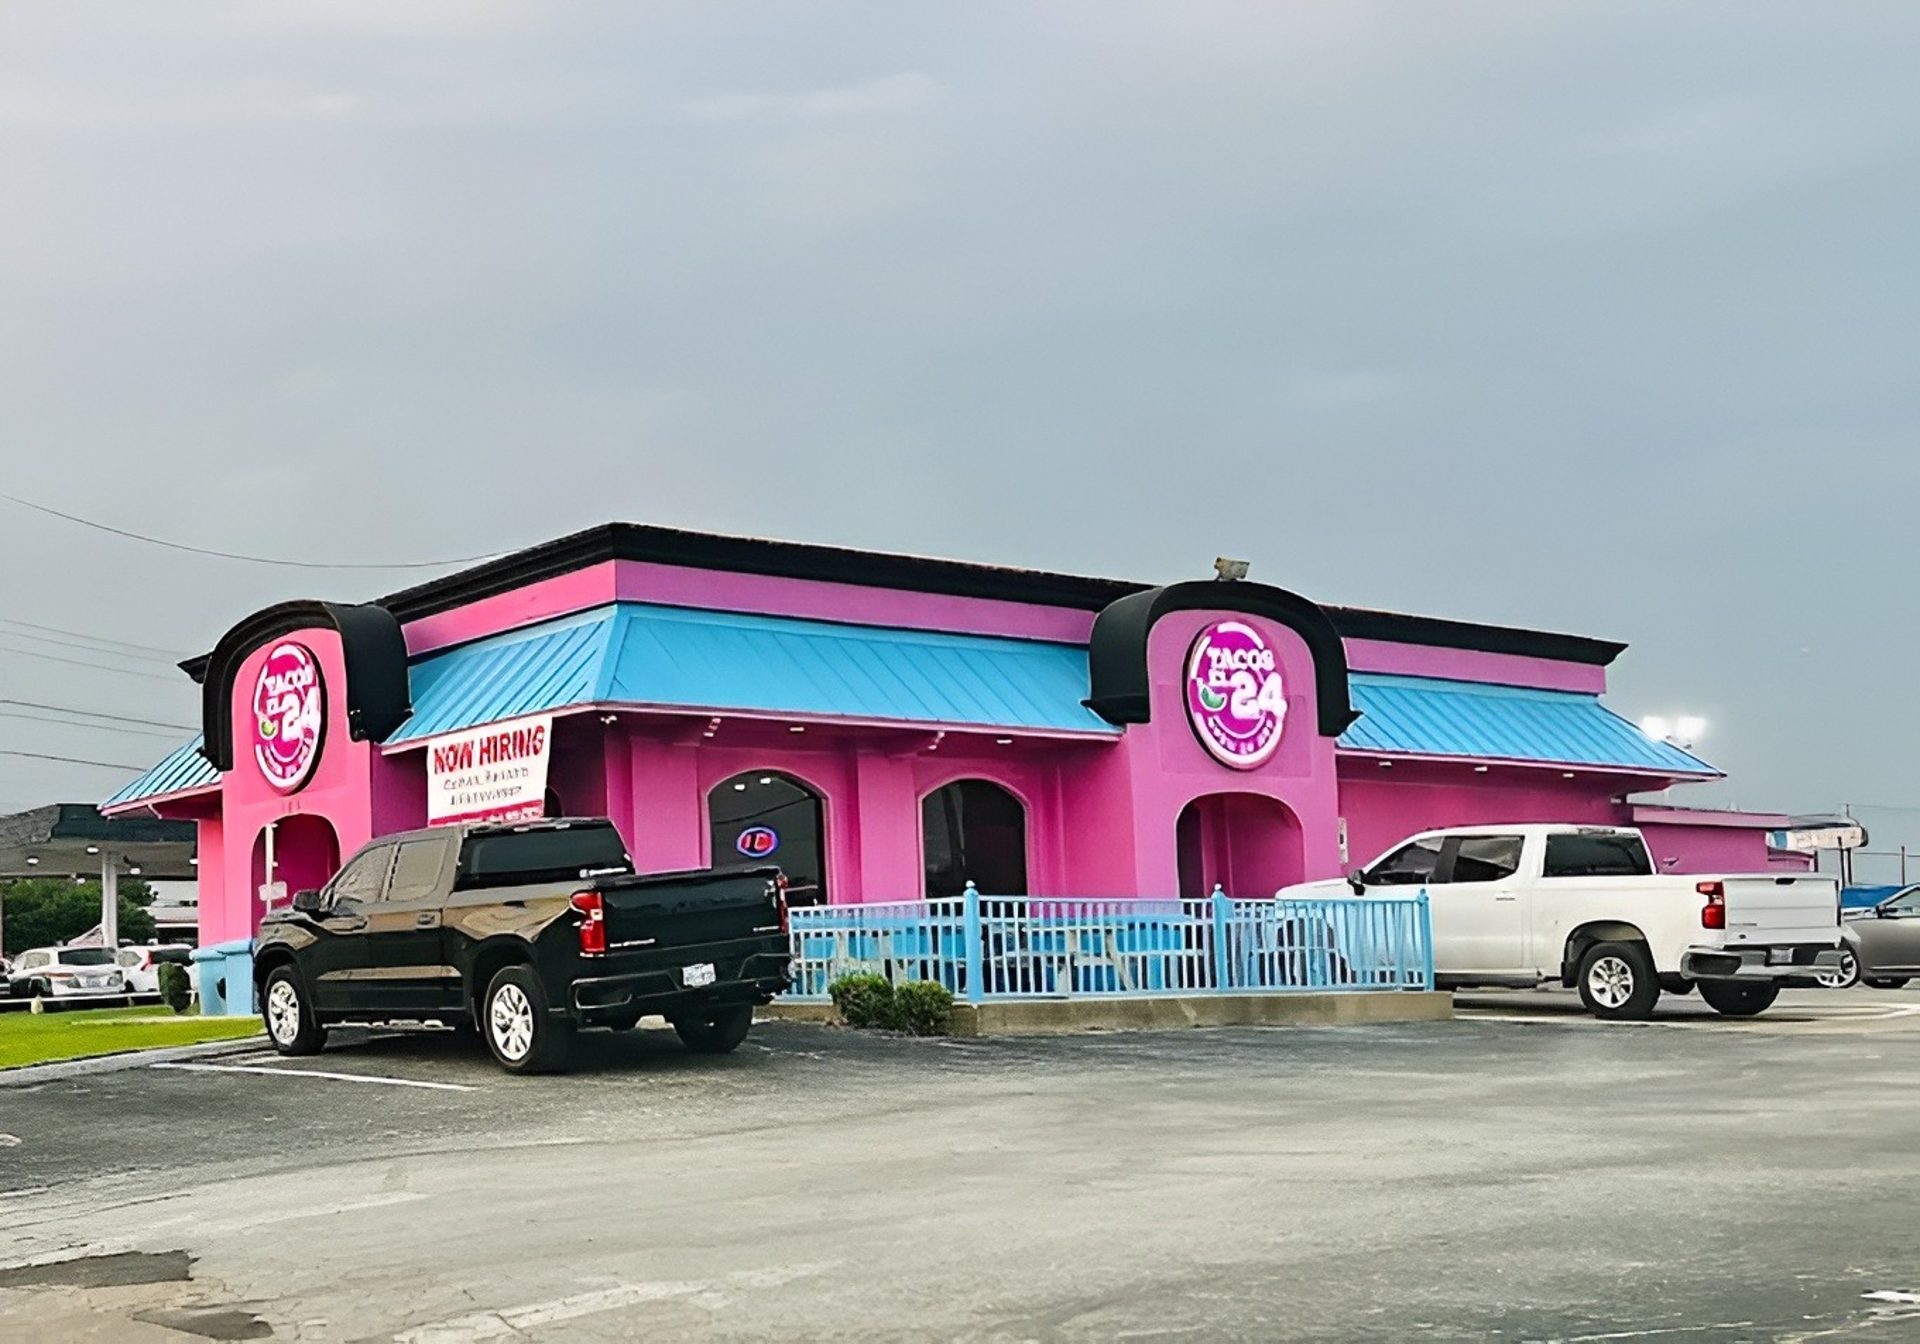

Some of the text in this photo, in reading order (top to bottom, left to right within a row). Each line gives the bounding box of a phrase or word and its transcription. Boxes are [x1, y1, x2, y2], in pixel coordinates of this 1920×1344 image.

[1207, 646, 1275, 671] TACOS
[281, 686, 322, 742] 24
[1230, 671, 1288, 720] 24
[433, 725, 545, 775] NOW HIRING
